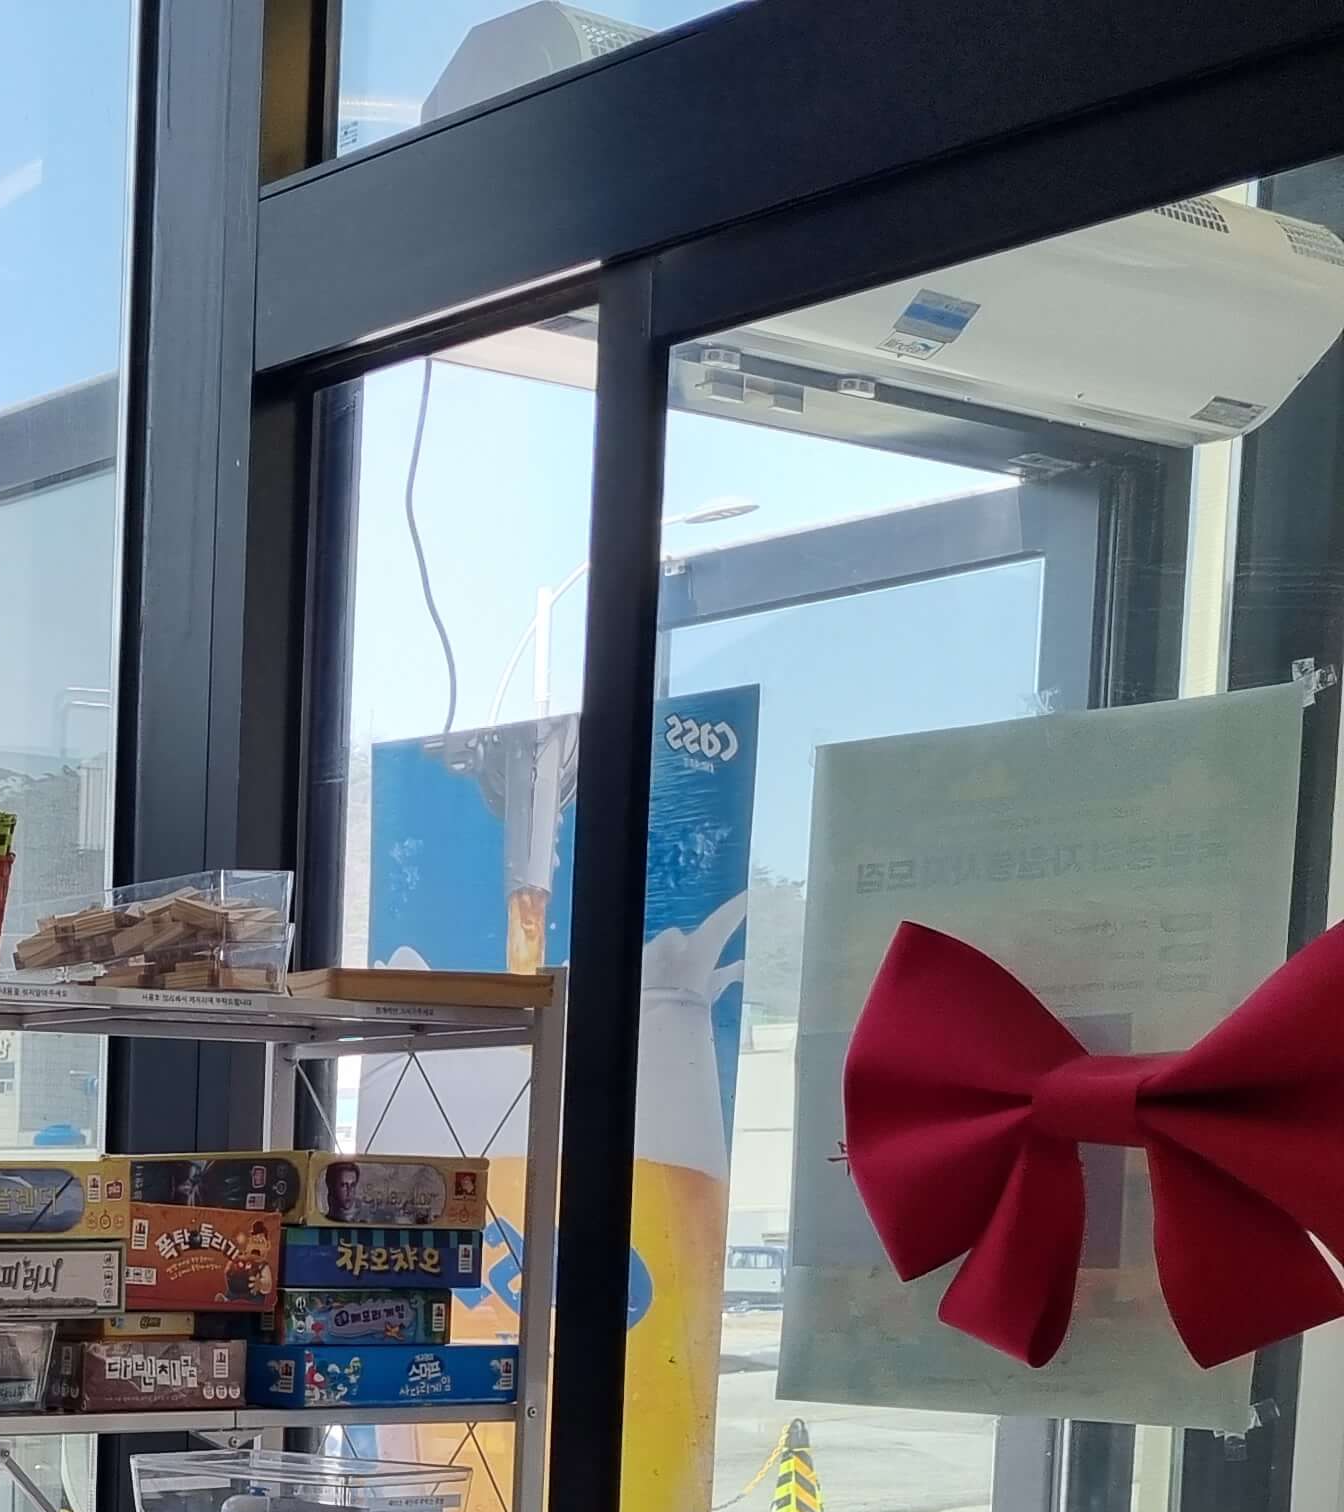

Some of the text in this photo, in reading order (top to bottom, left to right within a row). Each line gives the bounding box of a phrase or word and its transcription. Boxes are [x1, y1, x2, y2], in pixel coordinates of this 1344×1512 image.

[154, 1223, 240, 1261] 폭탄 돌리기
[21, 1256, 65, 1294] 러시
[384, 1304, 406, 1321] 게임
[407, 1361, 442, 1382] 스머프
